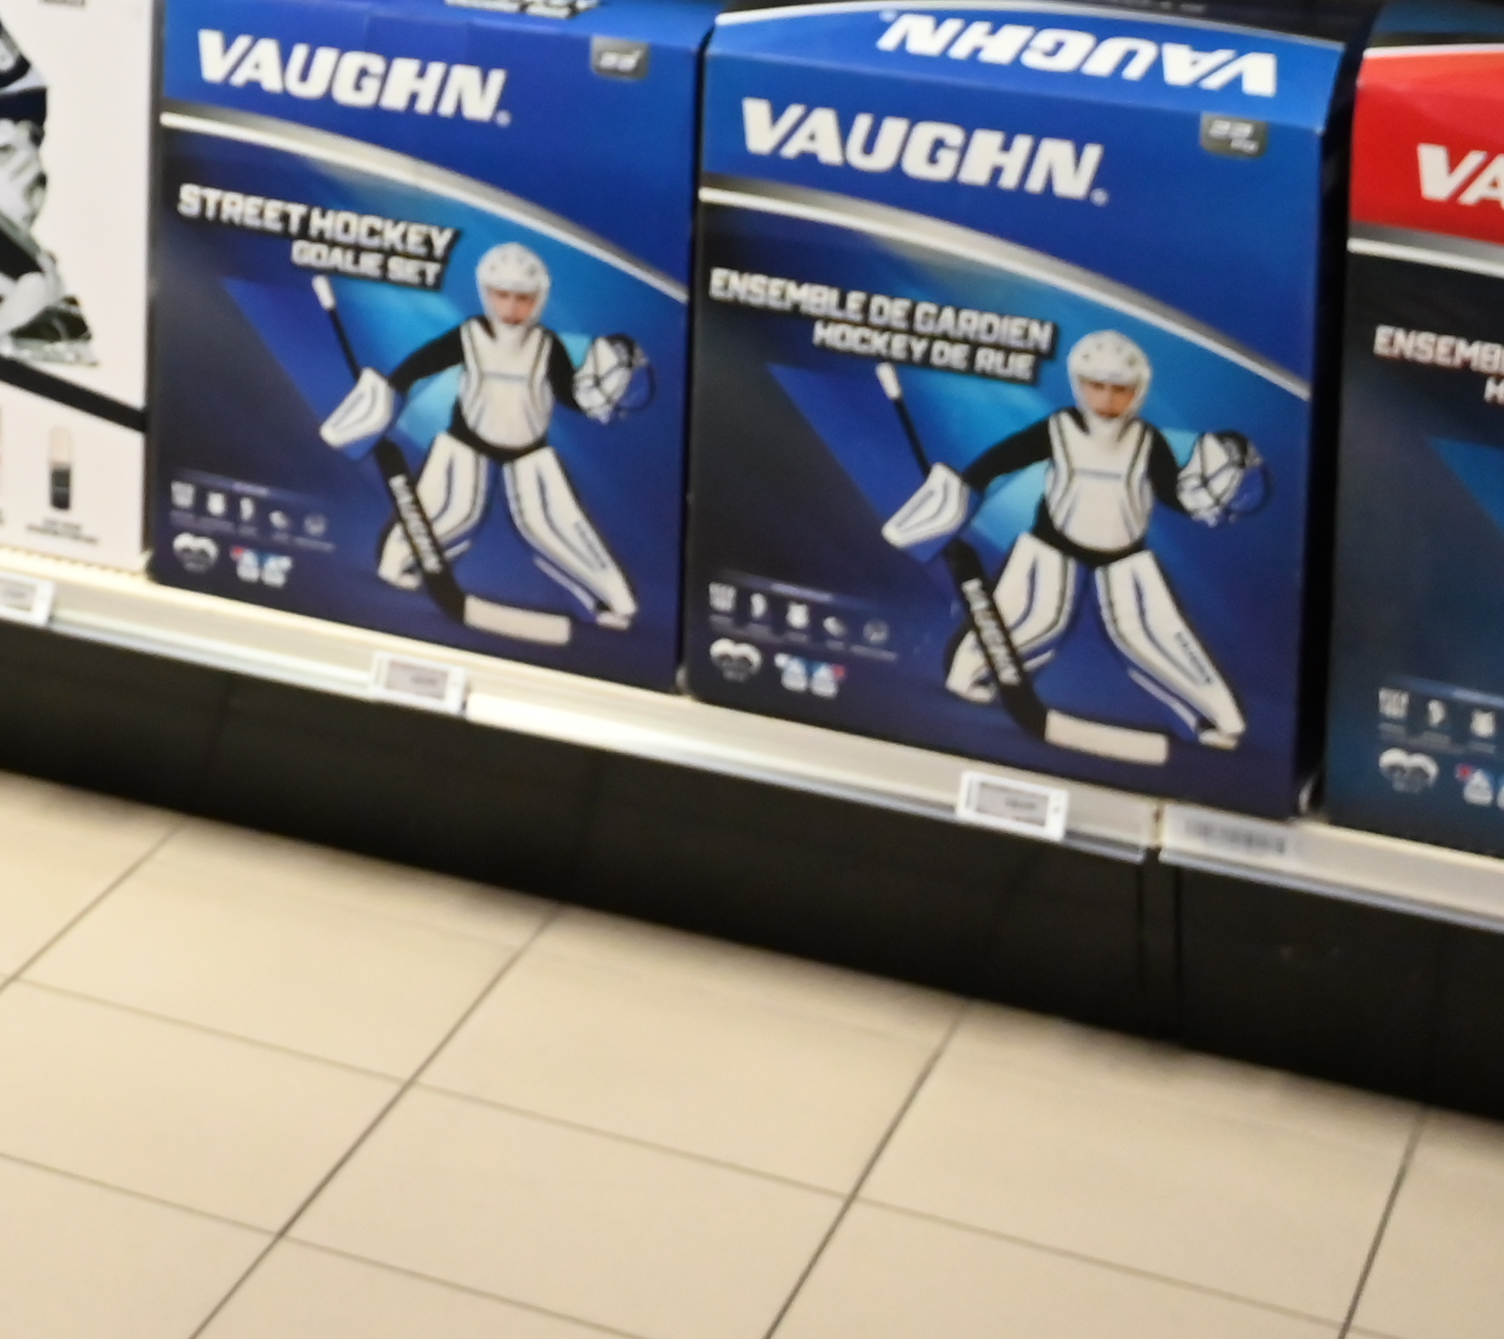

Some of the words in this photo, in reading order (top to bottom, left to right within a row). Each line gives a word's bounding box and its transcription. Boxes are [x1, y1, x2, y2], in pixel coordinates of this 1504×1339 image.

[197, 28, 507, 125] VAUGHN
[877, 11, 1279, 97] VAUGHN
[741, 95, 1104, 201] VAUGHN
[178, 182, 308, 235] STREET
[311, 203, 455, 257] HOCKEY
[291, 239, 382, 279] GOALIE
[389, 253, 443, 286] SET
[709, 267, 867, 323] ENSEMBLE
[870, 293, 910, 332] DE
[913, 300, 1053, 353] GARDIEN
[811, 318, 930, 367] HOCKEY
[932, 340, 969, 370] DE
[974, 346, 1036, 381] RUE
